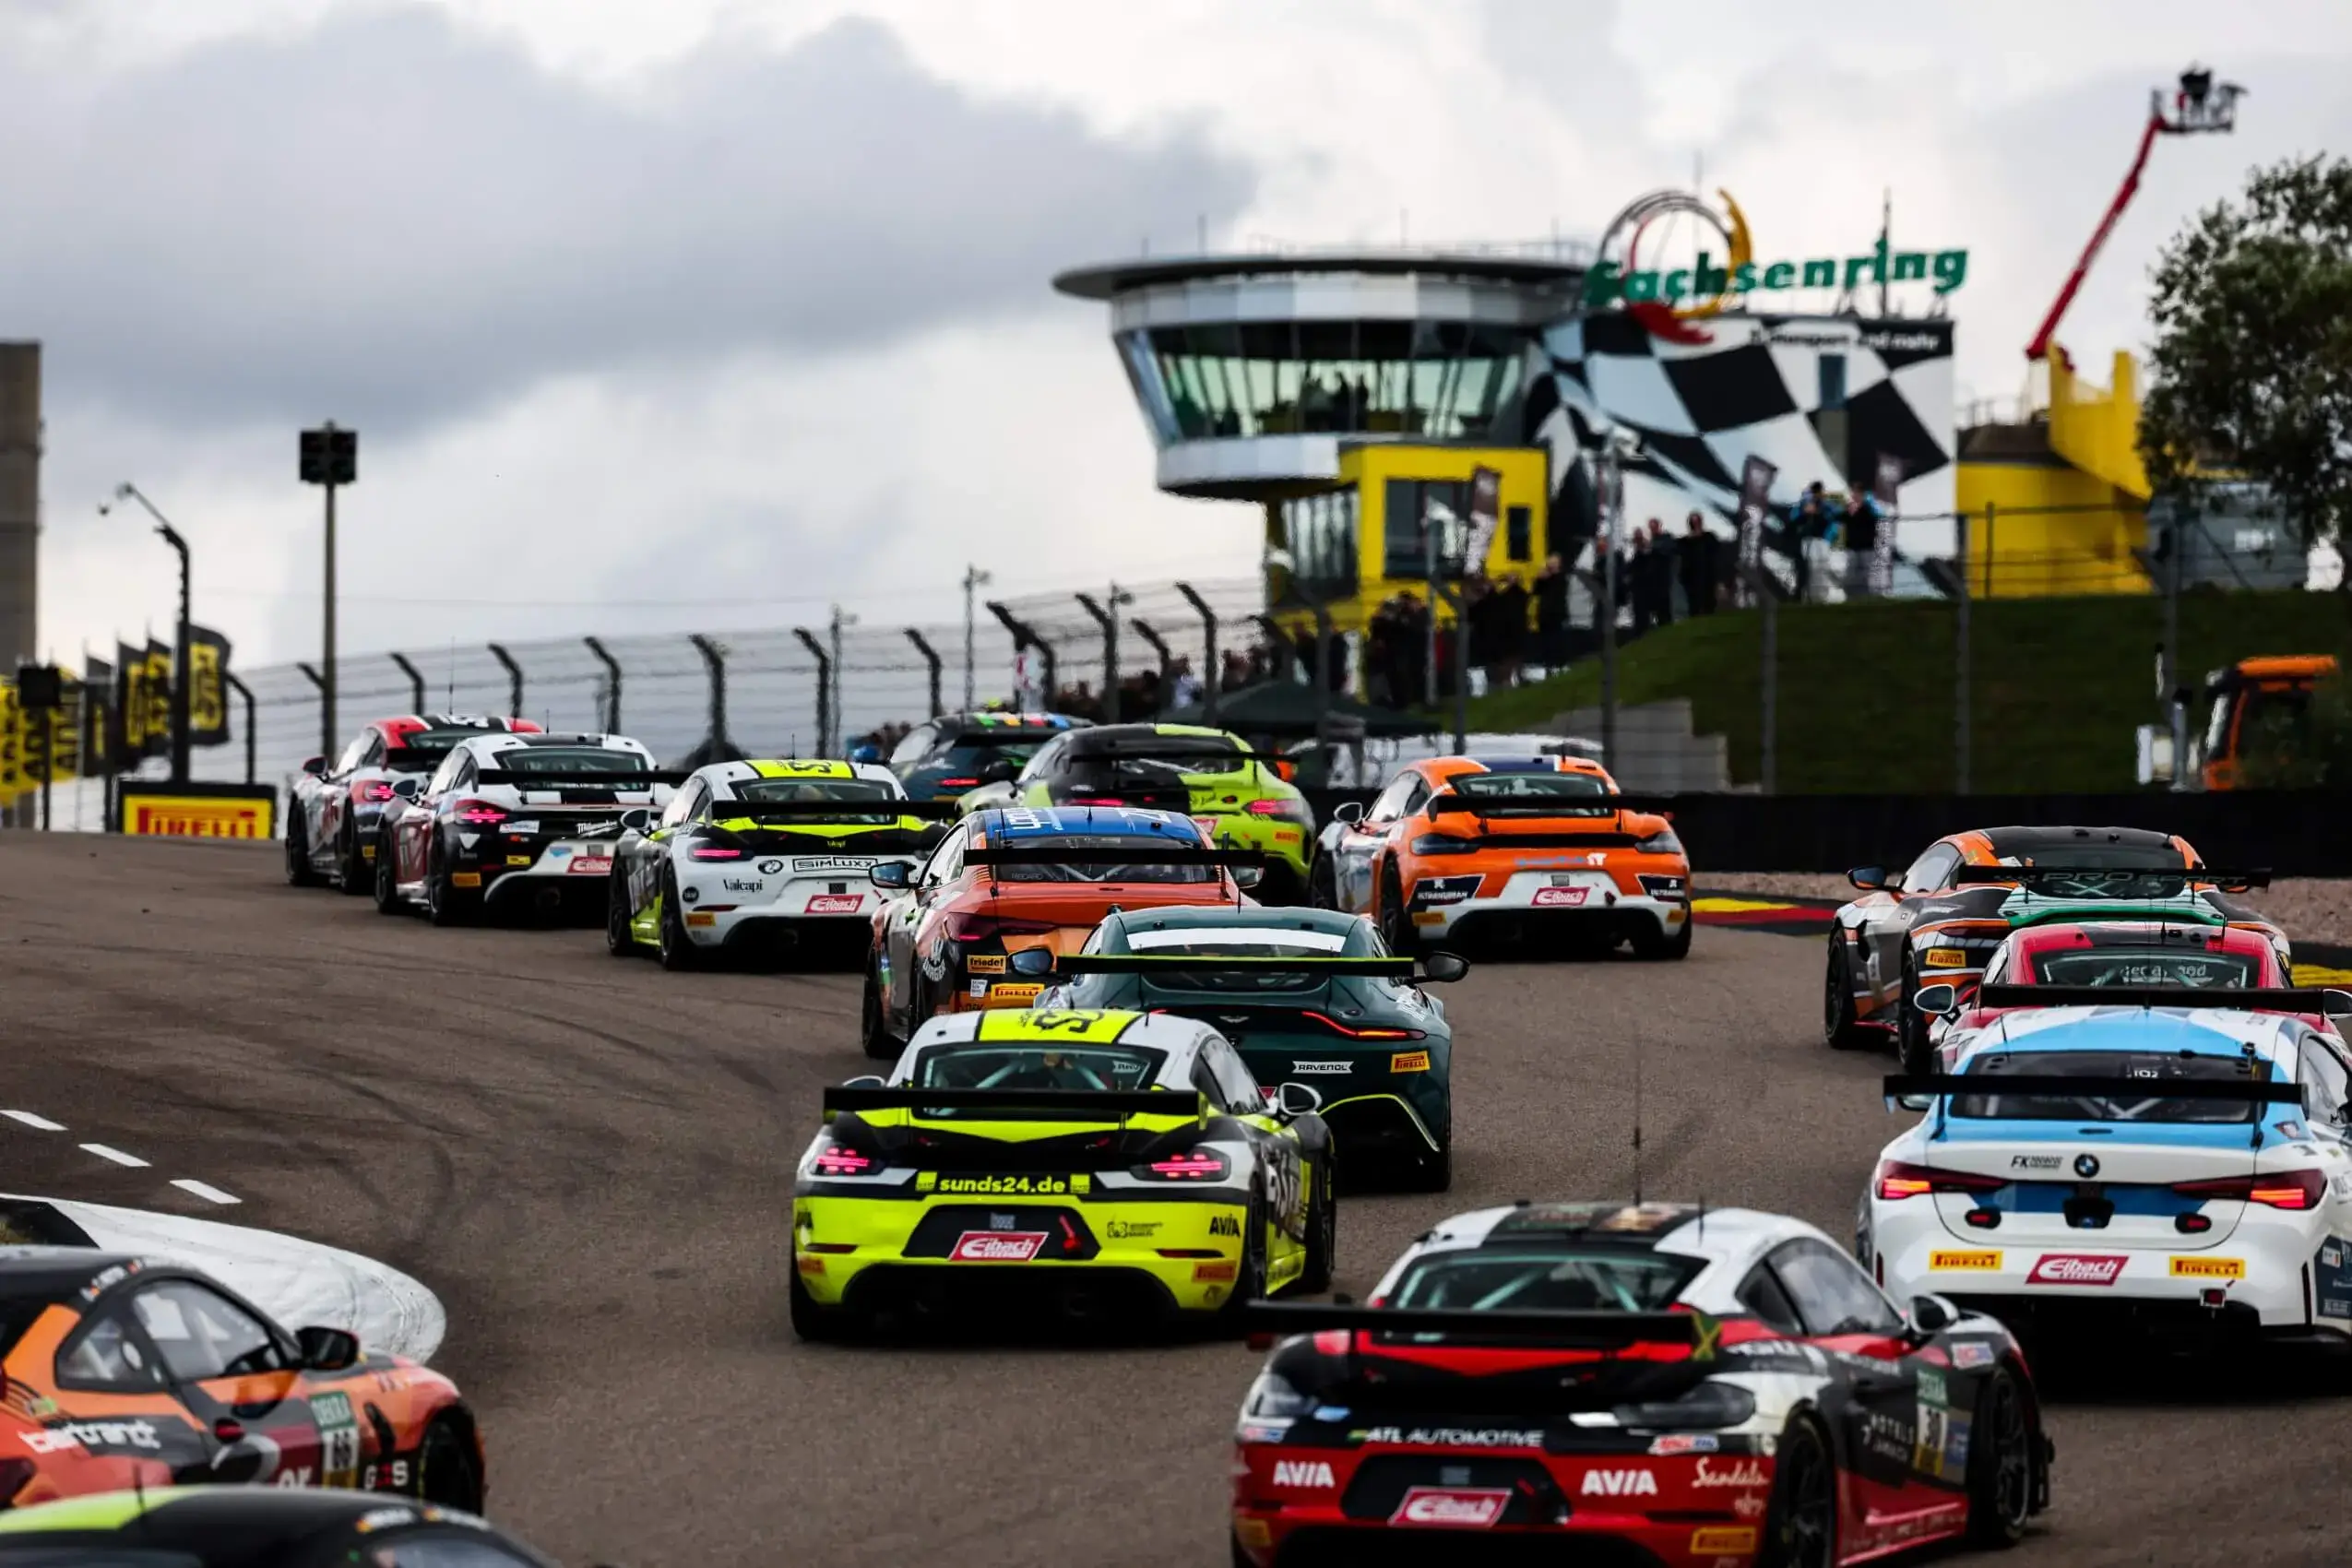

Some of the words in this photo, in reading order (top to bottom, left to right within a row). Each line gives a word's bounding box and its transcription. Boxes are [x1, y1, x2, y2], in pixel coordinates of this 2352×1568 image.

[1583, 235, 1968, 309] Sachsenring
[723, 878, 764, 893] Valcapi
[1298, 1063, 1348, 1072] RAVENOL
[1395, 1054, 1426, 1070] PIRELLI
[939, 1175, 1066, 1193] sunds24.de
[960, 1238, 1035, 1259] Eibach
[2037, 1257, 2119, 1280] Eibach
[1406, 1430, 1544, 1447] AUTOMOTIVE
[1273, 1460, 1336, 1489] AVIA
[1581, 1469, 1658, 1496] AVIA
